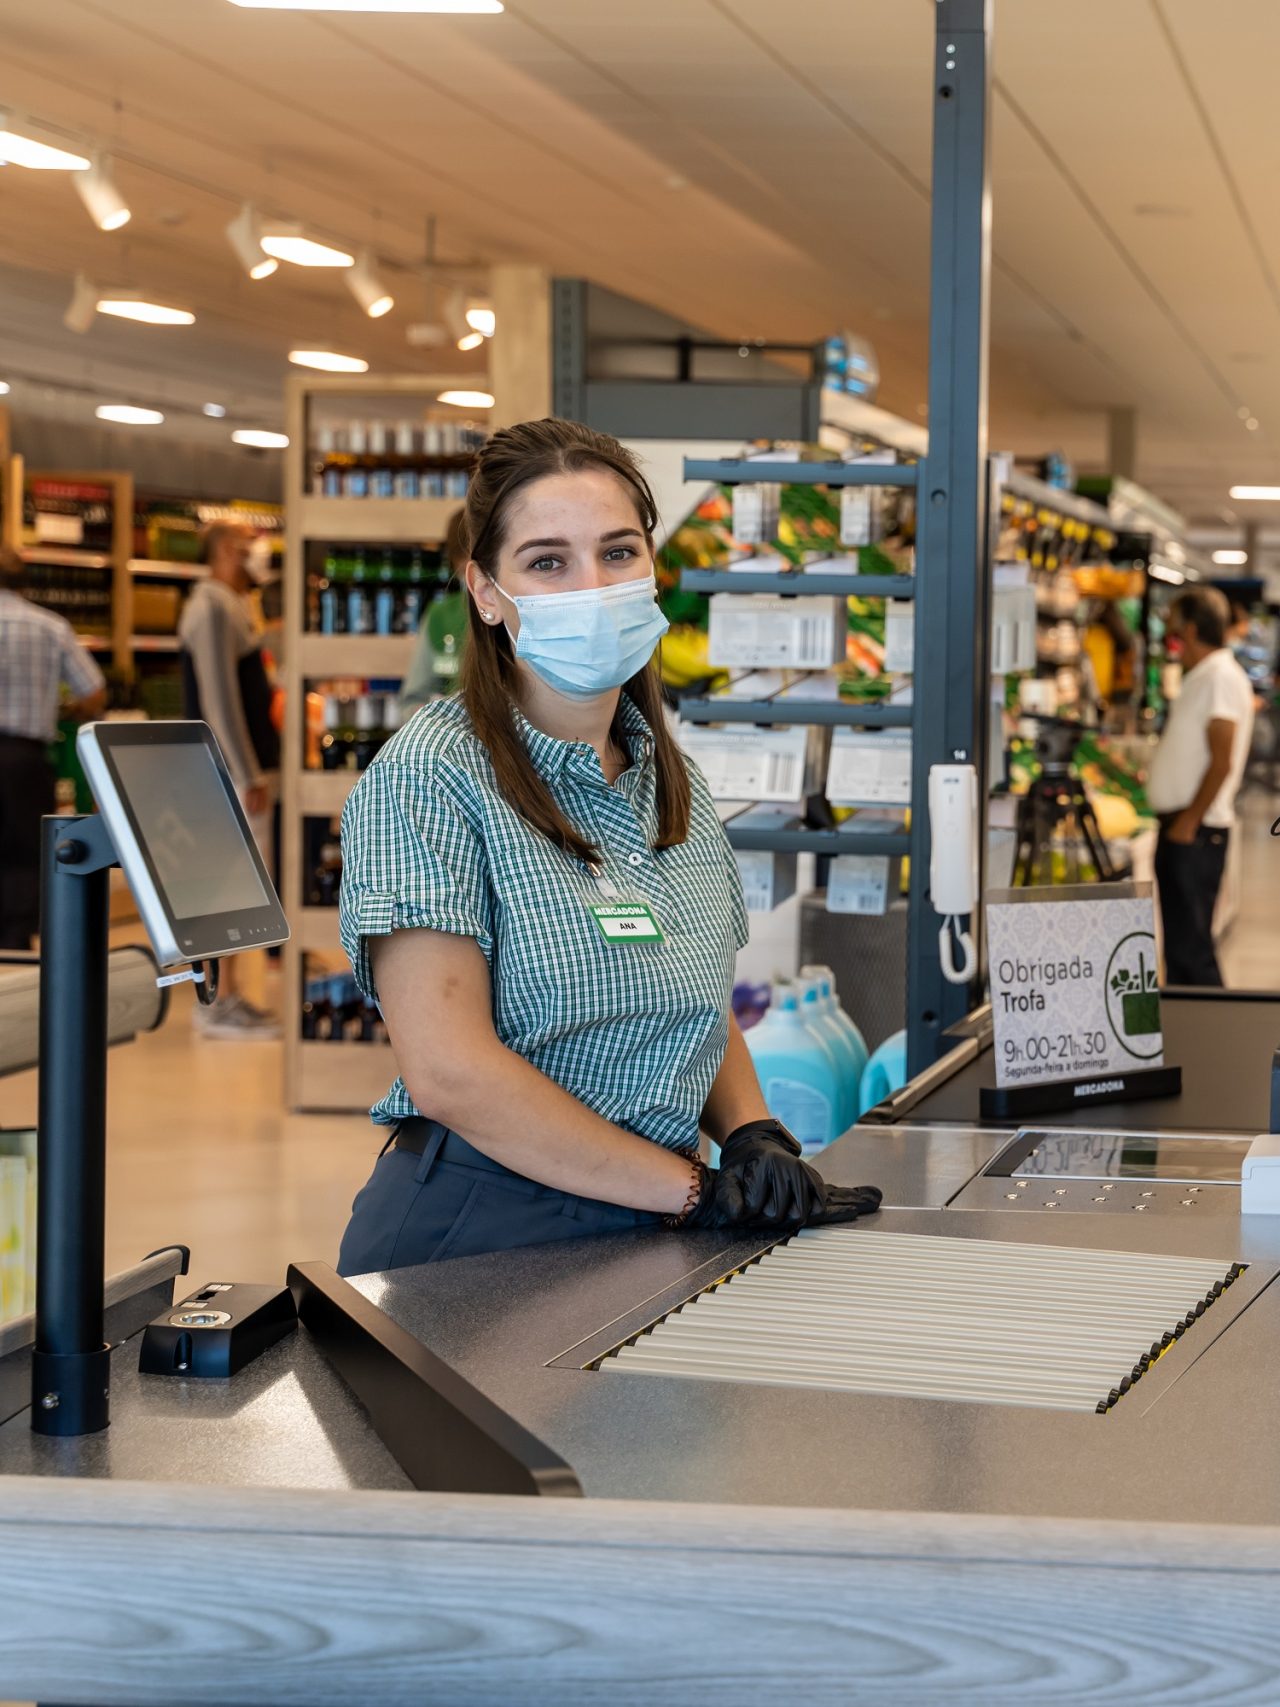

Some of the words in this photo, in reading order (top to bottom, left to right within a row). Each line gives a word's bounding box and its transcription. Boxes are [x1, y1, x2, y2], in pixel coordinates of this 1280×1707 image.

[594, 907, 647, 915] MERCADONA
[999, 956, 1093, 985] Obrigada
[1001, 989, 1045, 1012] Trofa
[1004, 1062, 1064, 1078] Segunda-feira
[1065, 1063, 1071, 1071] a
[1072, 1058, 1109, 1070] domingo
[1074, 1081, 1124, 1096] MERCADONA
